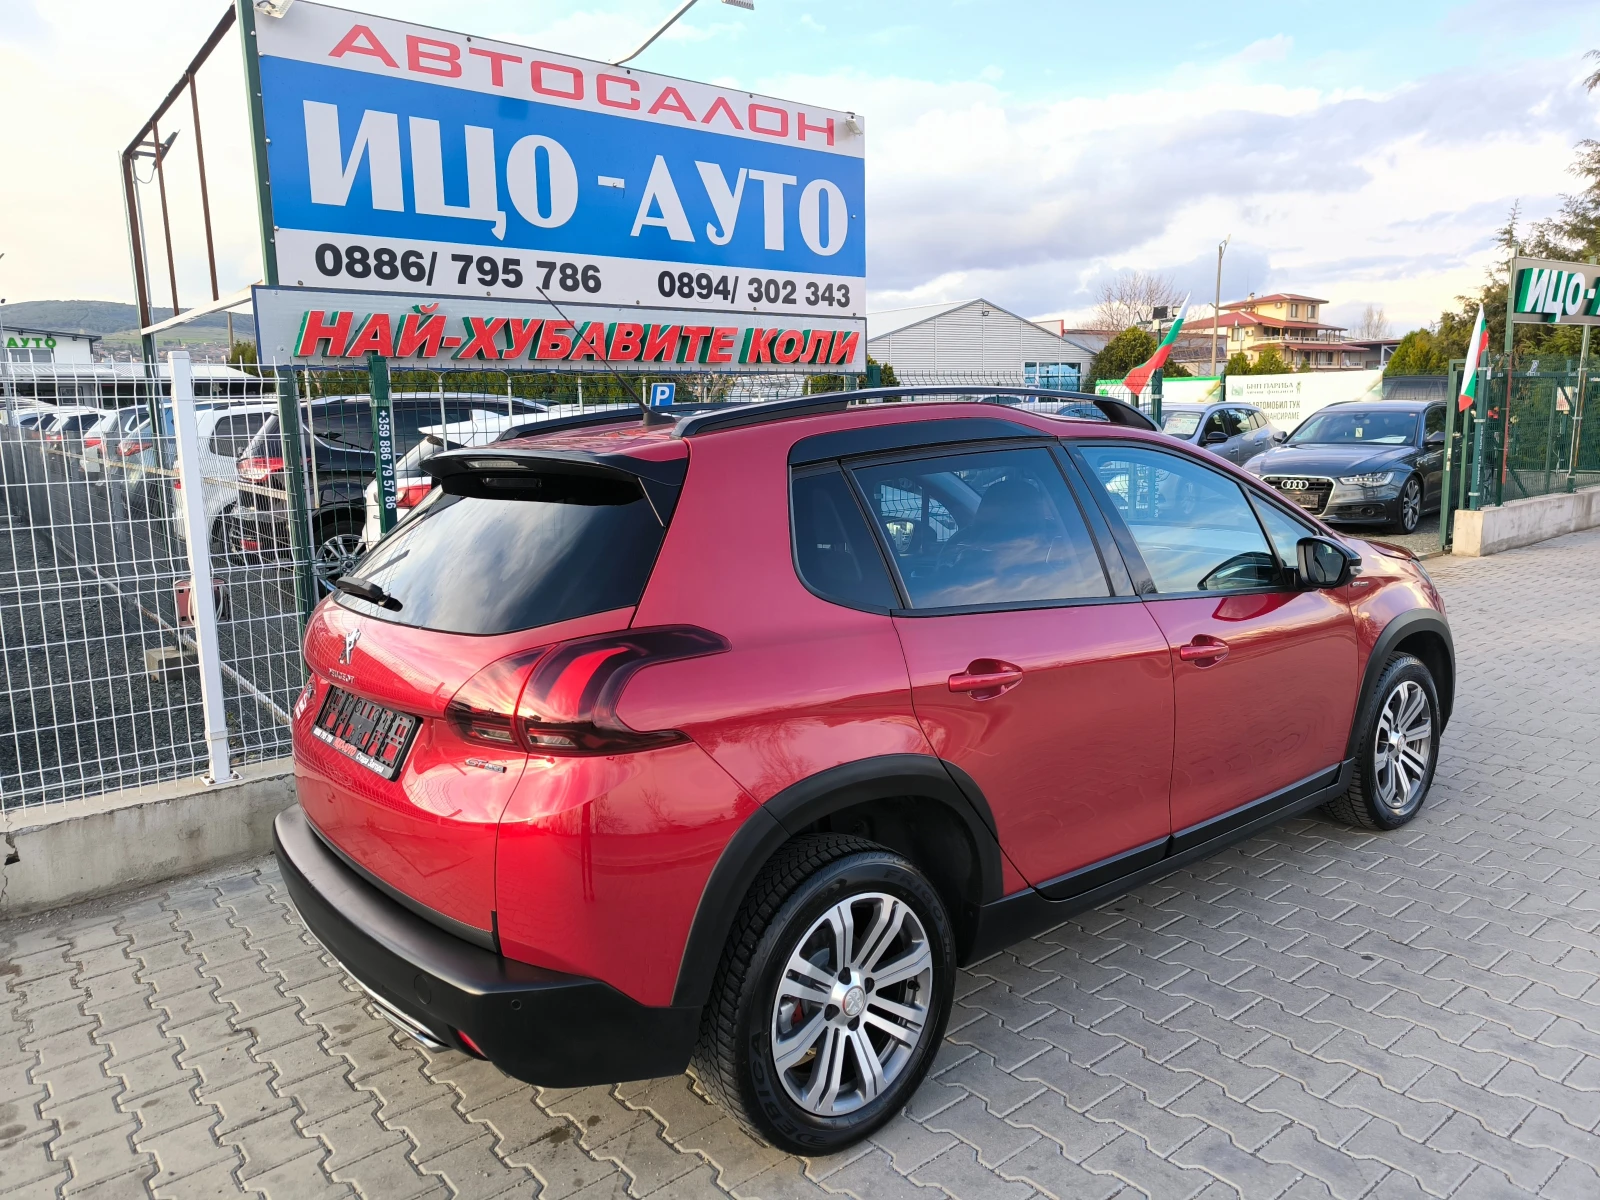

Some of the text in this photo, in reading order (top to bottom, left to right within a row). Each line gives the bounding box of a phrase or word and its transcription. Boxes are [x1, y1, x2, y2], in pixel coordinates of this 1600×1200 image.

[329, 24, 835, 146] АВТОСАЛОН
[315, 243, 601, 294] 0886/ 795 786
[657, 270, 850, 308] 0894/ 302 343
[1518, 267, 1600, 323] ИЦО-
[7, 337, 57, 349] АУТО
[294, 303, 859, 365] НАЙ-ХУБАВИТЕ КОЛИ
[655, 386, 670, 405] P
[1289, 400, 1300, 409] ТУК
[378, 409, 396, 509] +359 886 79 57 86
